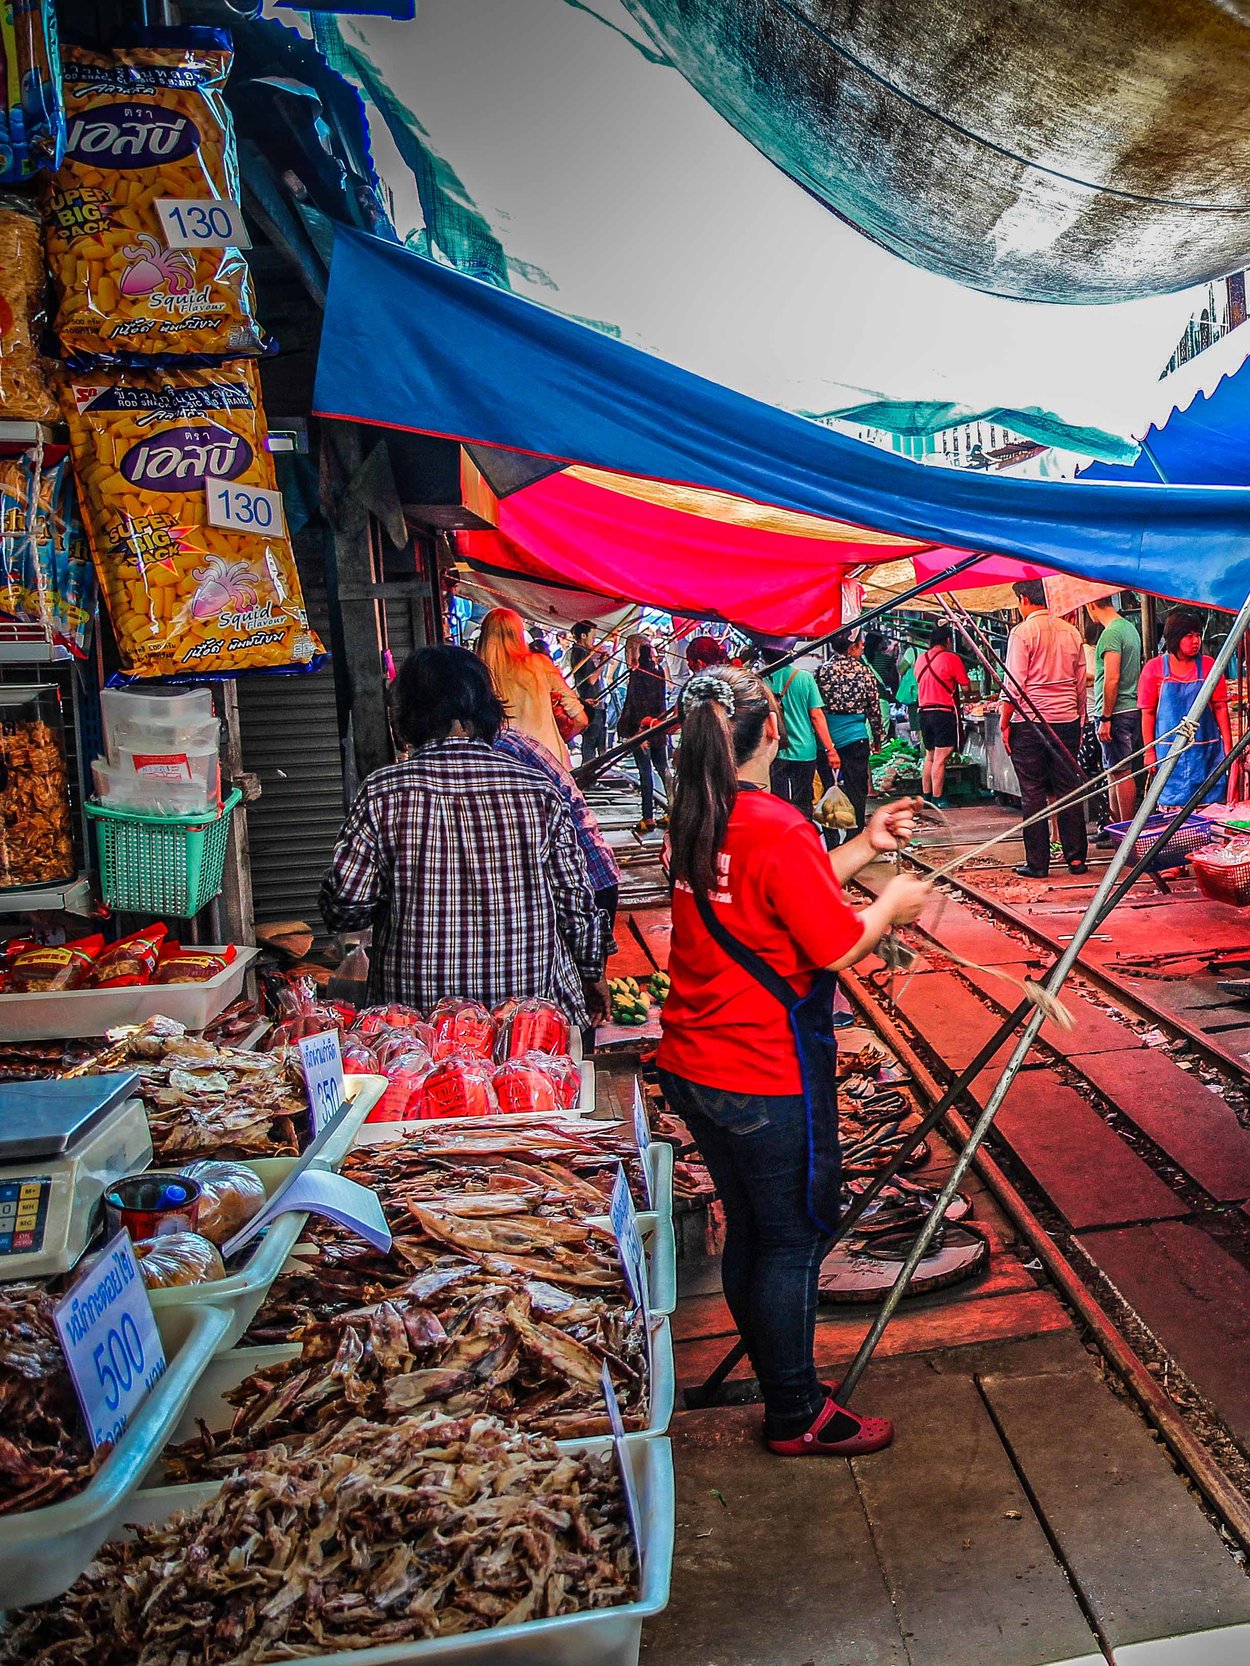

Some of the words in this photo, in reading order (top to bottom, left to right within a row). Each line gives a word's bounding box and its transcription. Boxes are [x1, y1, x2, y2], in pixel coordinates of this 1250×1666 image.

[124, 108, 153, 118] ตรา
[65, 118, 187, 154] เอสบี
[50, 187, 111, 210] UPER
[58, 203, 101, 227] BIG
[168, 206, 232, 239] 130
[57, 220, 110, 238] PACK
[150, 287, 209, 312] Squid
[181, 302, 225, 313] Flavour
[118, 399, 138, 407] ROD
[225, 397, 249, 405] RAND
[184, 432, 211, 441] ตรา
[131, 436, 240, 480] เอสบี
[217, 489, 272, 527] 130
[109, 514, 177, 543] SUPER
[126, 531, 171, 553] BIG
[127, 545, 179, 566] PACK
[218, 602, 271, 631] Squid
[247, 616, 286, 630] Flavour
[317, 1077, 340, 1124] 350
[2, 1204, 11, 1214] 0
[93, 1312, 145, 1411] 500
